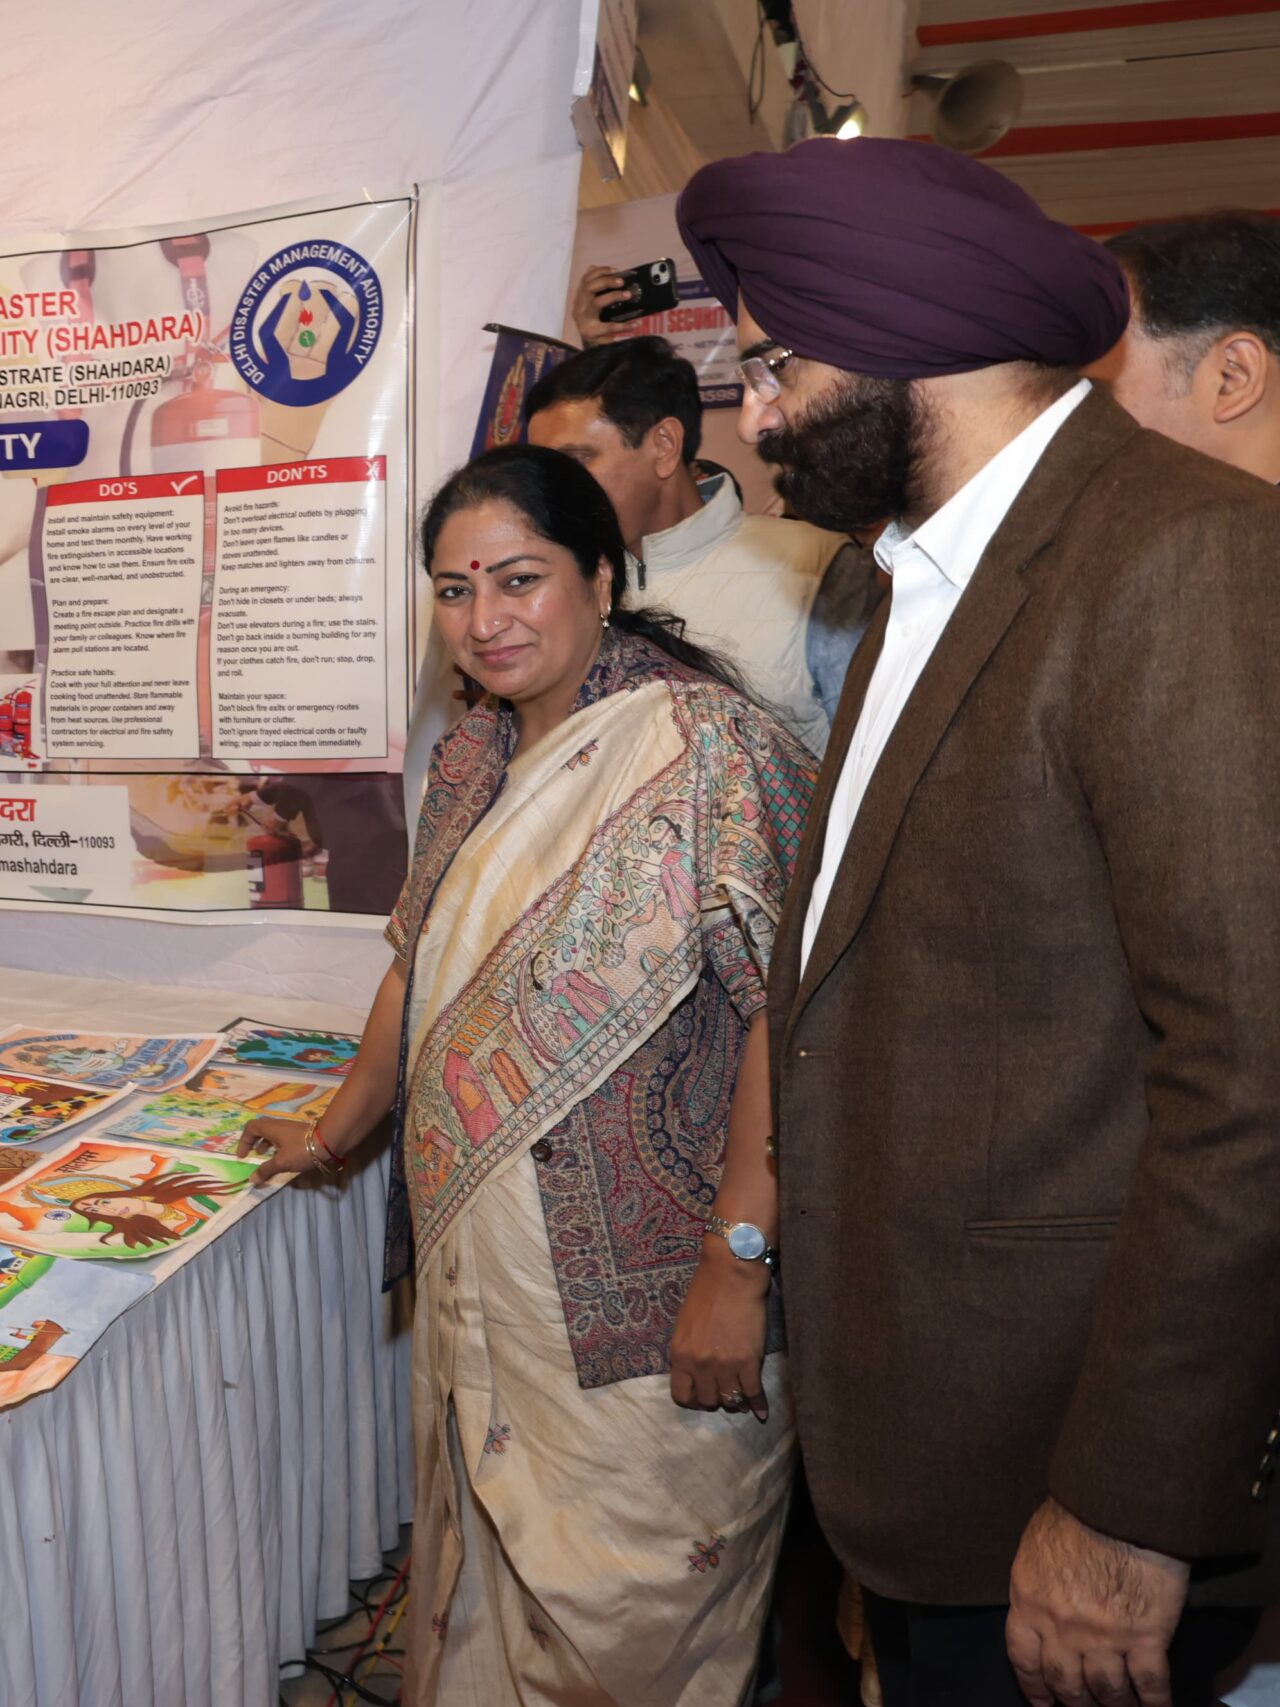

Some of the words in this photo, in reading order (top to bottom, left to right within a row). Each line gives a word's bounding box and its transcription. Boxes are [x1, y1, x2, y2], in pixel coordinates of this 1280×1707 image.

[268, 244, 369, 279] MANAGEMENT
[233, 271, 271, 341] DISASTER
[354, 278, 380, 365] AUTHORITY
[46, 312, 203, 359] (SHAHDARA)
[69, 355, 172, 385] (SHAHDARA)
[232, 345, 265, 385] DELHI
[55, 379, 160, 406] DELHI-110093
[99, 481, 139, 498] DO'S
[267, 465, 328, 485] DON'TS
